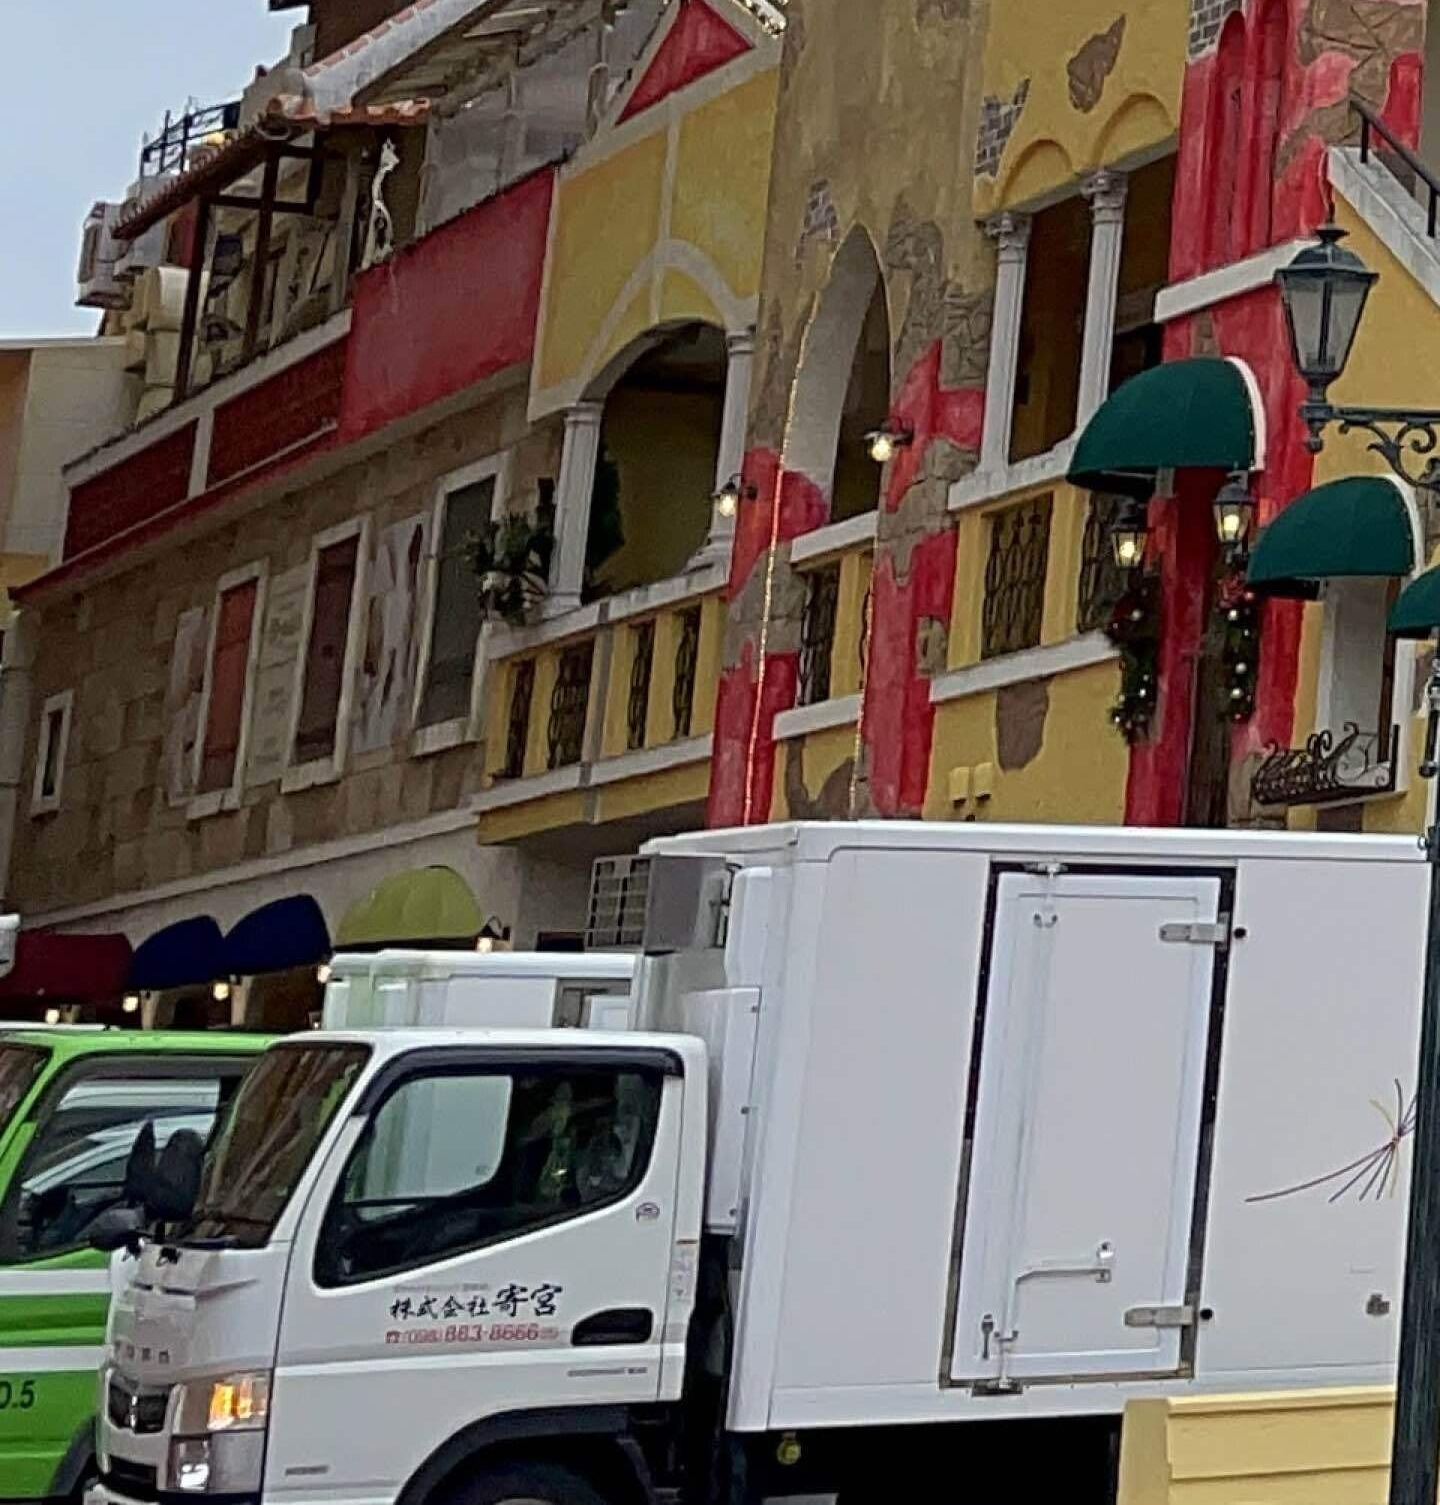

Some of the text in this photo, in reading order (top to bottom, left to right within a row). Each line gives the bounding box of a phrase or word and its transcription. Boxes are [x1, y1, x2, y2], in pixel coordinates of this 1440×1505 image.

[389, 1282, 563, 1321] 株式会社寄宮
